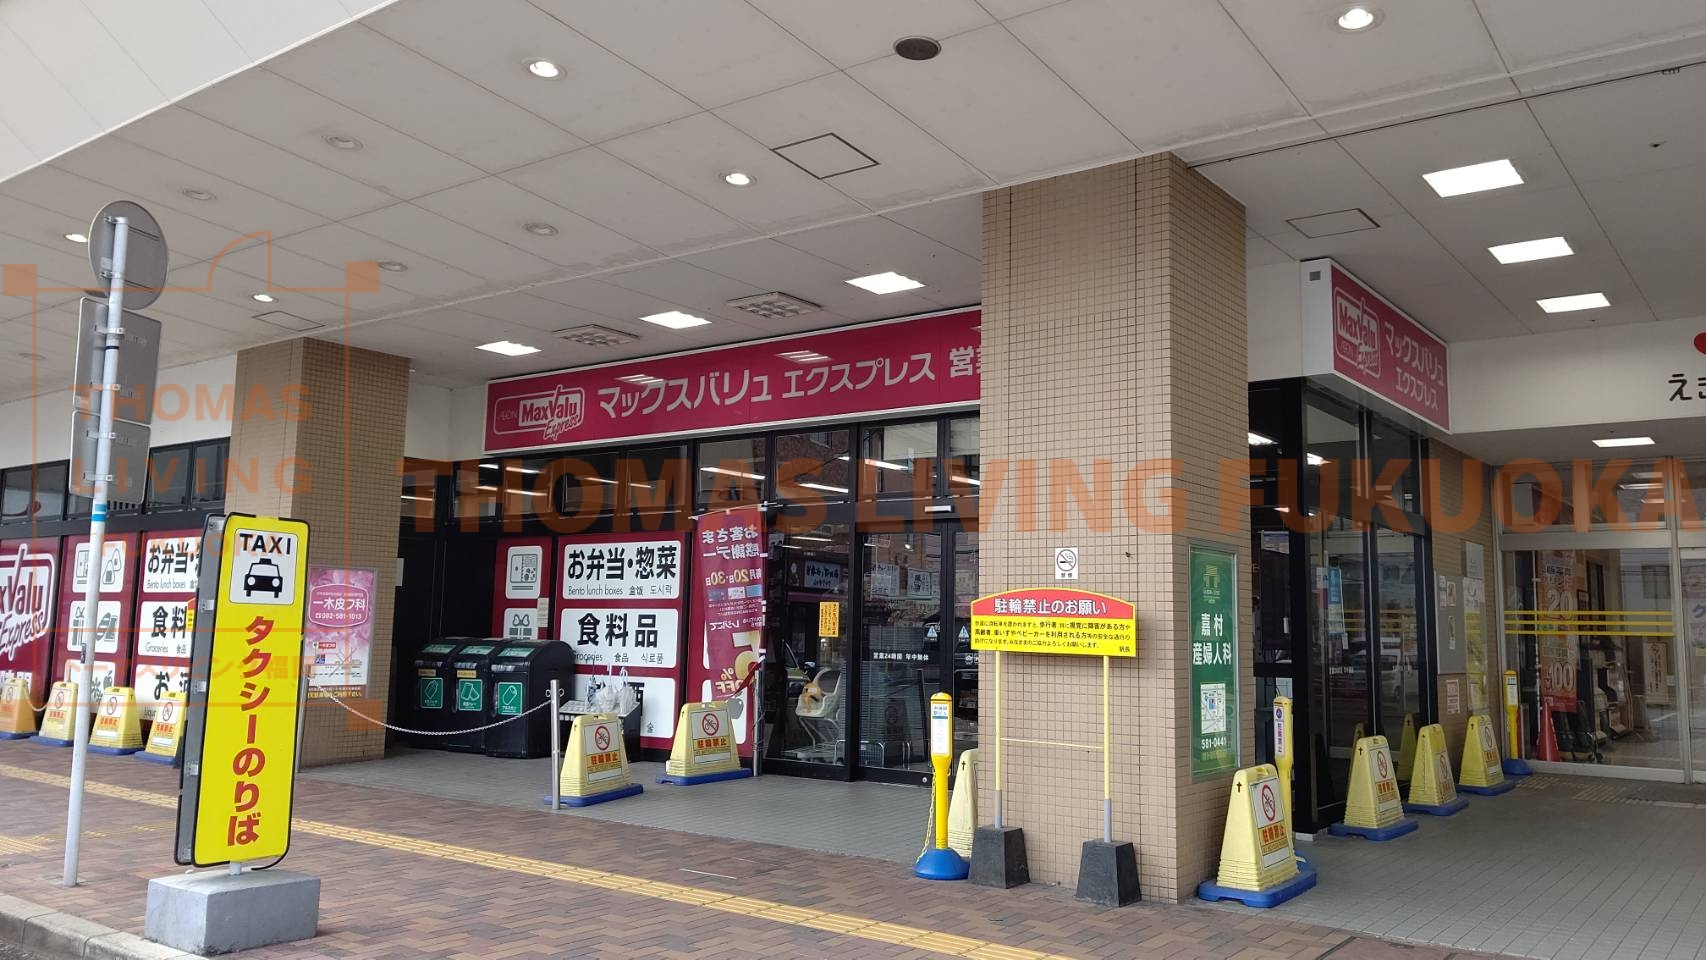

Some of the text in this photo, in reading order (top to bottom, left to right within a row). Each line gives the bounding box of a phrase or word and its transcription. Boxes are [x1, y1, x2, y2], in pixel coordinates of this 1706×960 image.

[1338, 298, 1376, 349] MaxValu
[1384, 321, 1444, 386] マックスバリュ
[597, 369, 772, 418] マックスバリュ
[782, 352, 936, 398] エクスプレス
[1395, 367, 1439, 411] エクスプレス
[521, 384, 578, 423] MaxValu
[544, 414, 580, 439] Express
[239, 533, 292, 555] TAXI
[567, 545, 678, 581] お弁当・惣菜
[312, 597, 366, 611] 一木皮フ科
[568, 585, 586, 596] Bento
[586, 584, 603, 596] lunch
[604, 584, 624, 596] boxes
[650, 584, 673, 596] 도시락
[994, 598, 1107, 615] 駐輪禁止のお願い
[577, 612, 659, 648] 食料品
[1201, 612, 1224, 637] 嘉村
[614, 652, 629, 663] 食品
[641, 653, 664, 664] 식료품
[1192, 641, 1232, 666] 産婦人科
[227, 615, 275, 847] タクシーのりば
